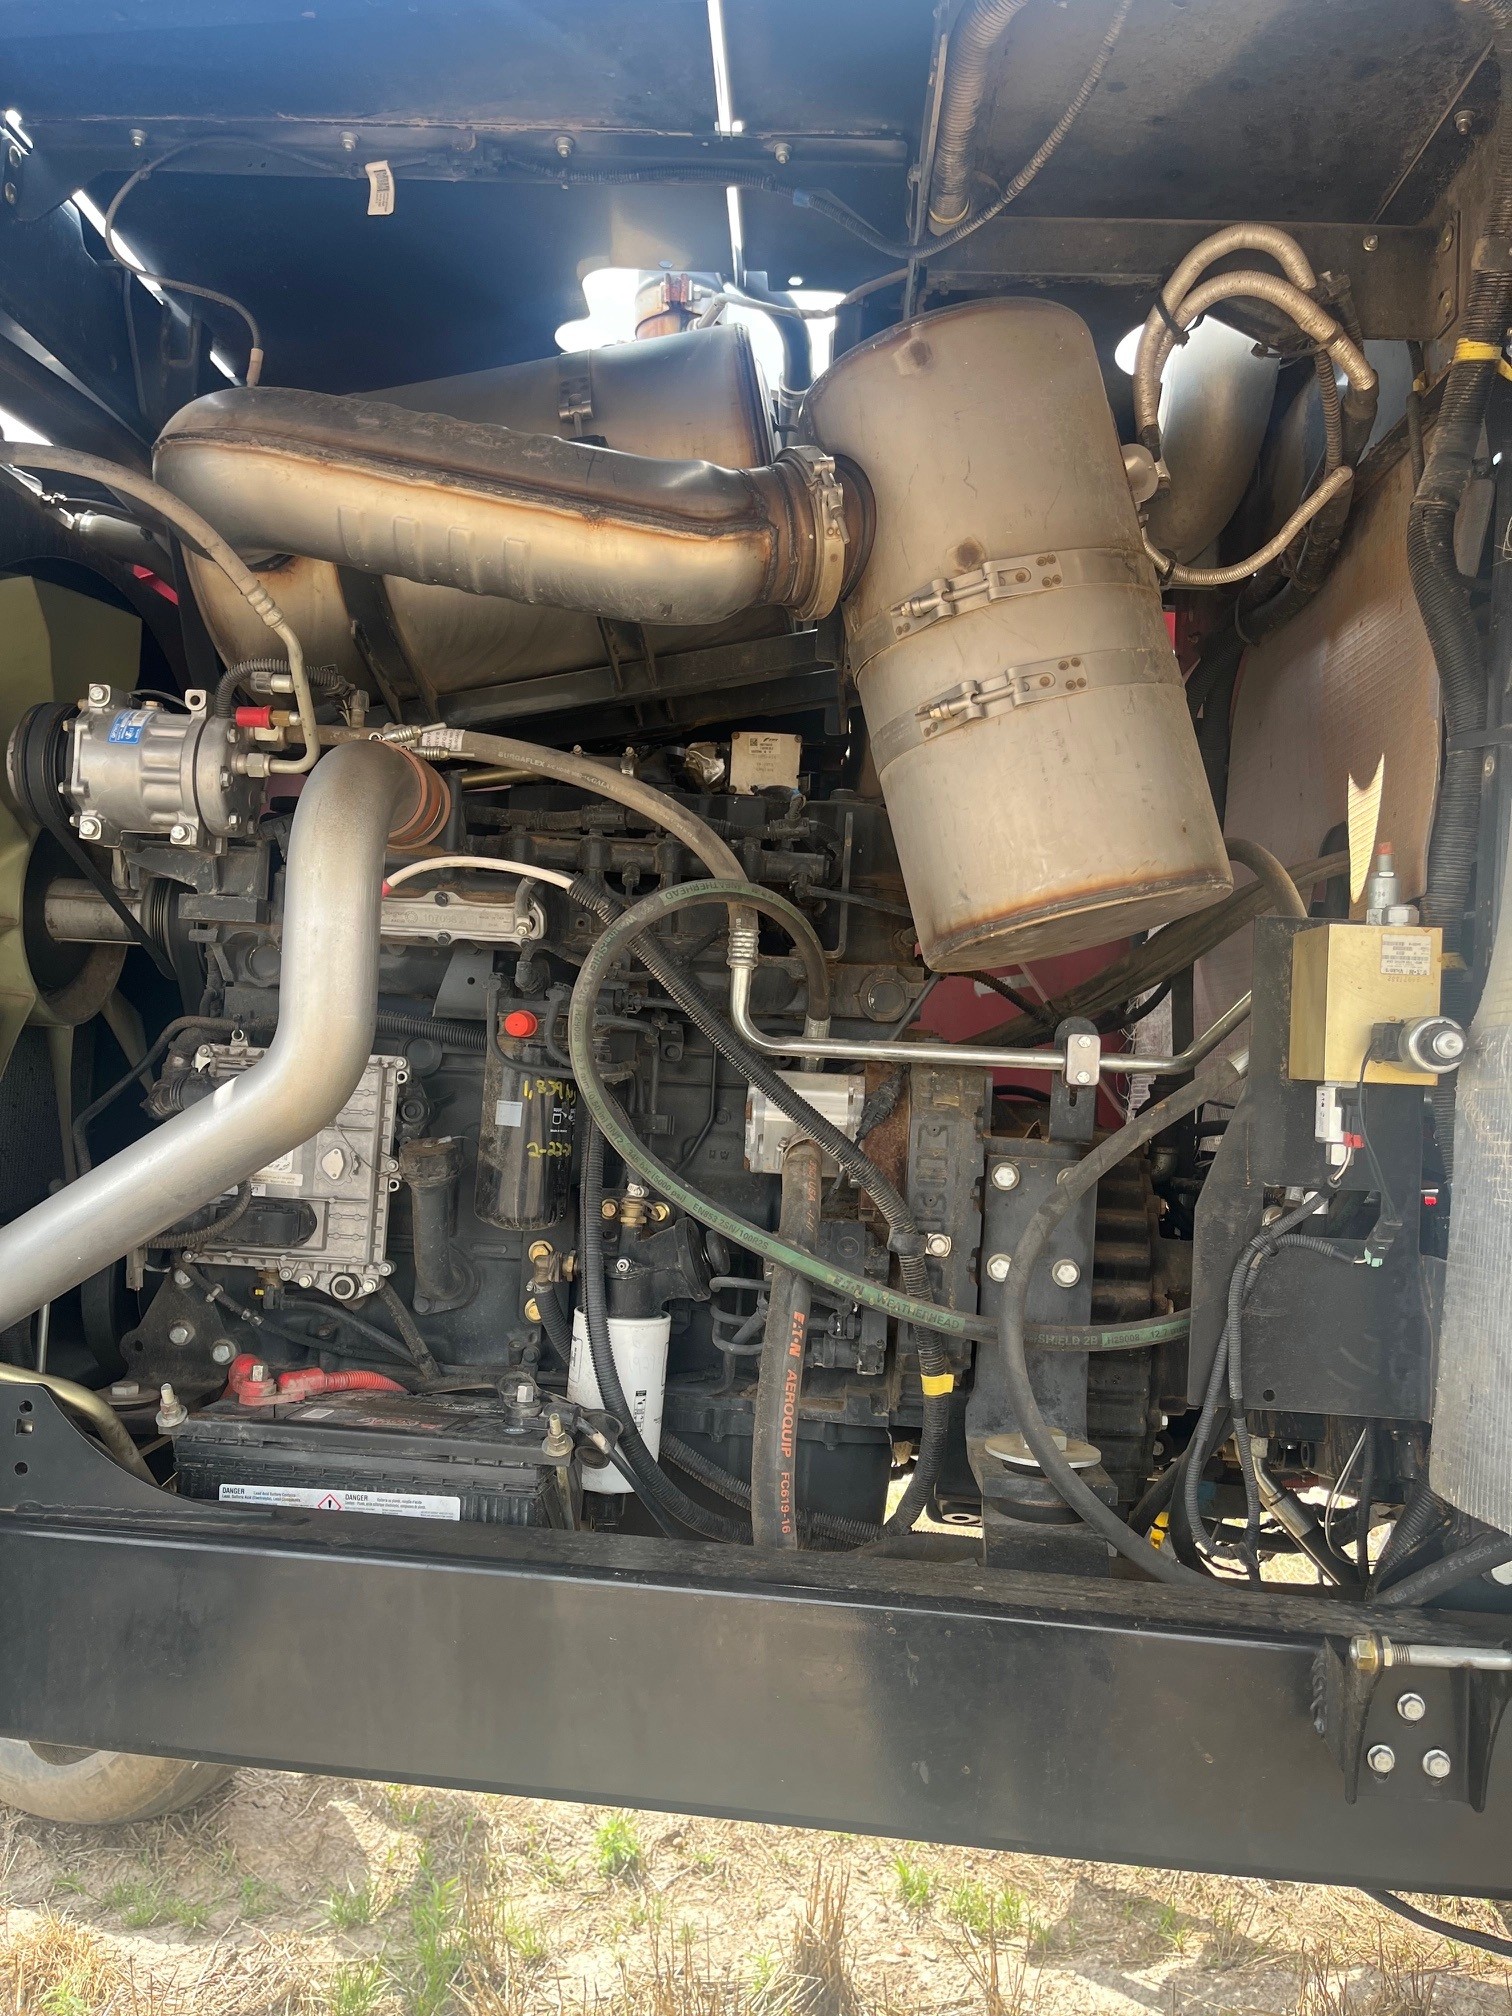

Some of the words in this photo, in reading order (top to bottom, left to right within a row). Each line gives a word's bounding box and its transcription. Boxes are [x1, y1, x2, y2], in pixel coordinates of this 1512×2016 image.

[638, 1160, 652, 1176] bar
[651, 1172, 672, 1192] (5000
[692, 1201, 718, 1223] EN853
[876, 1290, 961, 1330] WEATHERHEAD
[781, 1369, 798, 1458] AEROQUIP
[222, 1486, 245, 1495] DANGER
[780, 1472, 791, 1535] FC619-16
